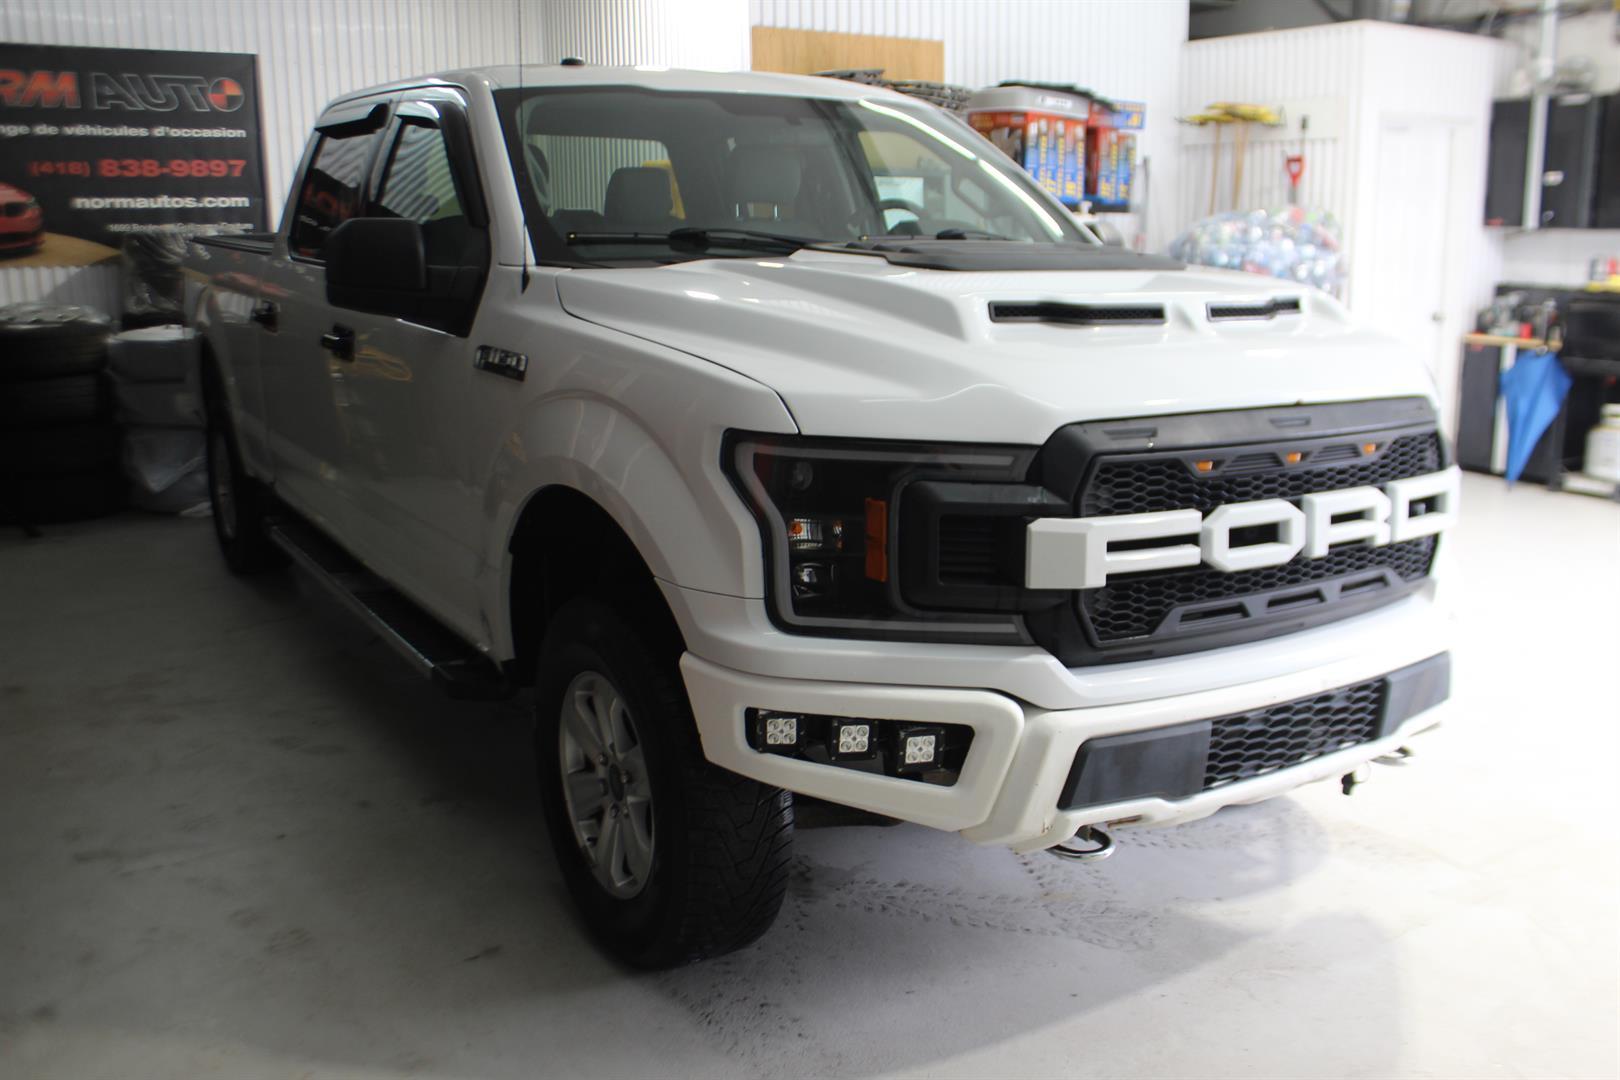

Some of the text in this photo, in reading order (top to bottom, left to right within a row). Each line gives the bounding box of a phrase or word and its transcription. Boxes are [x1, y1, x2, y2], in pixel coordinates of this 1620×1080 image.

[34, 123, 59, 136] de
[63, 123, 149, 137] véhicules
[152, 126, 246, 138] d'occasion
[31, 159, 246, 177] (418) 838-9897
[72, 194, 249, 209] normautos.com
[1025, 465, 1461, 590] FORD
